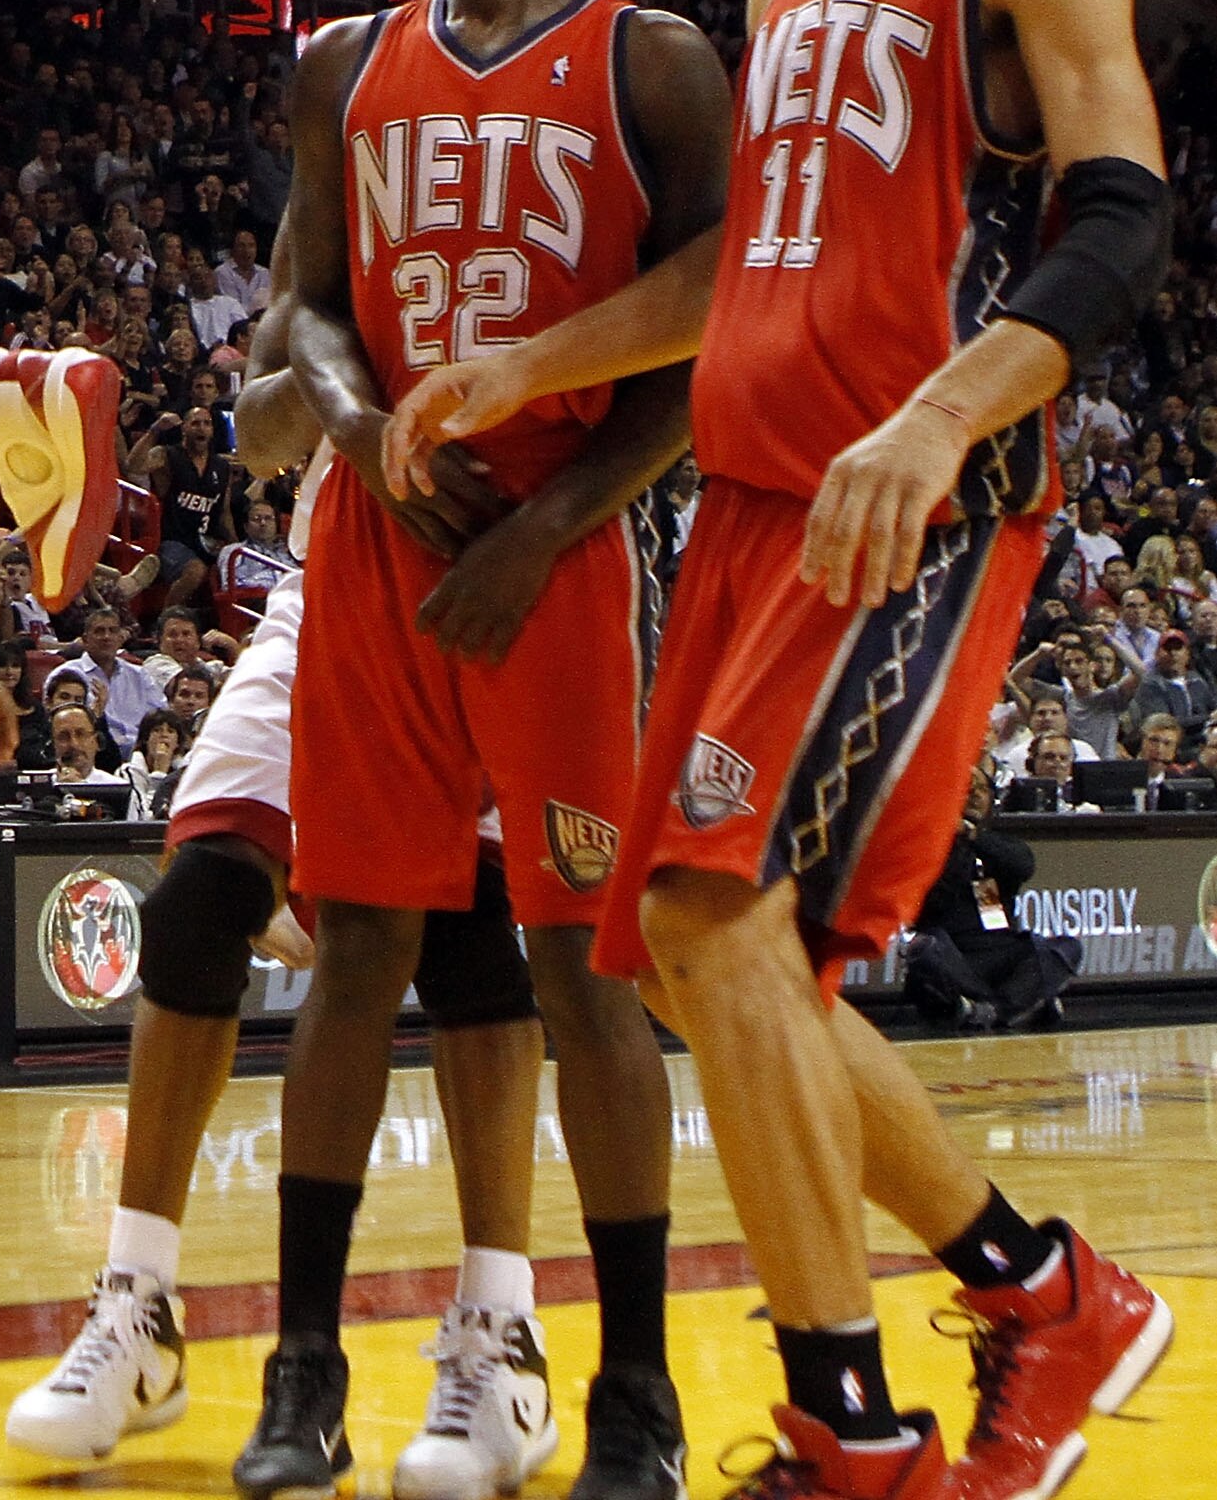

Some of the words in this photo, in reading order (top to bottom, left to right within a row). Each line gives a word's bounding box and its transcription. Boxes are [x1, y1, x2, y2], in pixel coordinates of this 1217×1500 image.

[351, 113, 598, 278] NETS
[742, 138, 828, 269] 11
[392, 247, 531, 371] 22
[178, 491, 221, 513] HEAT
[197, 514, 210, 535] 3
[554, 805, 617, 860] NETS
